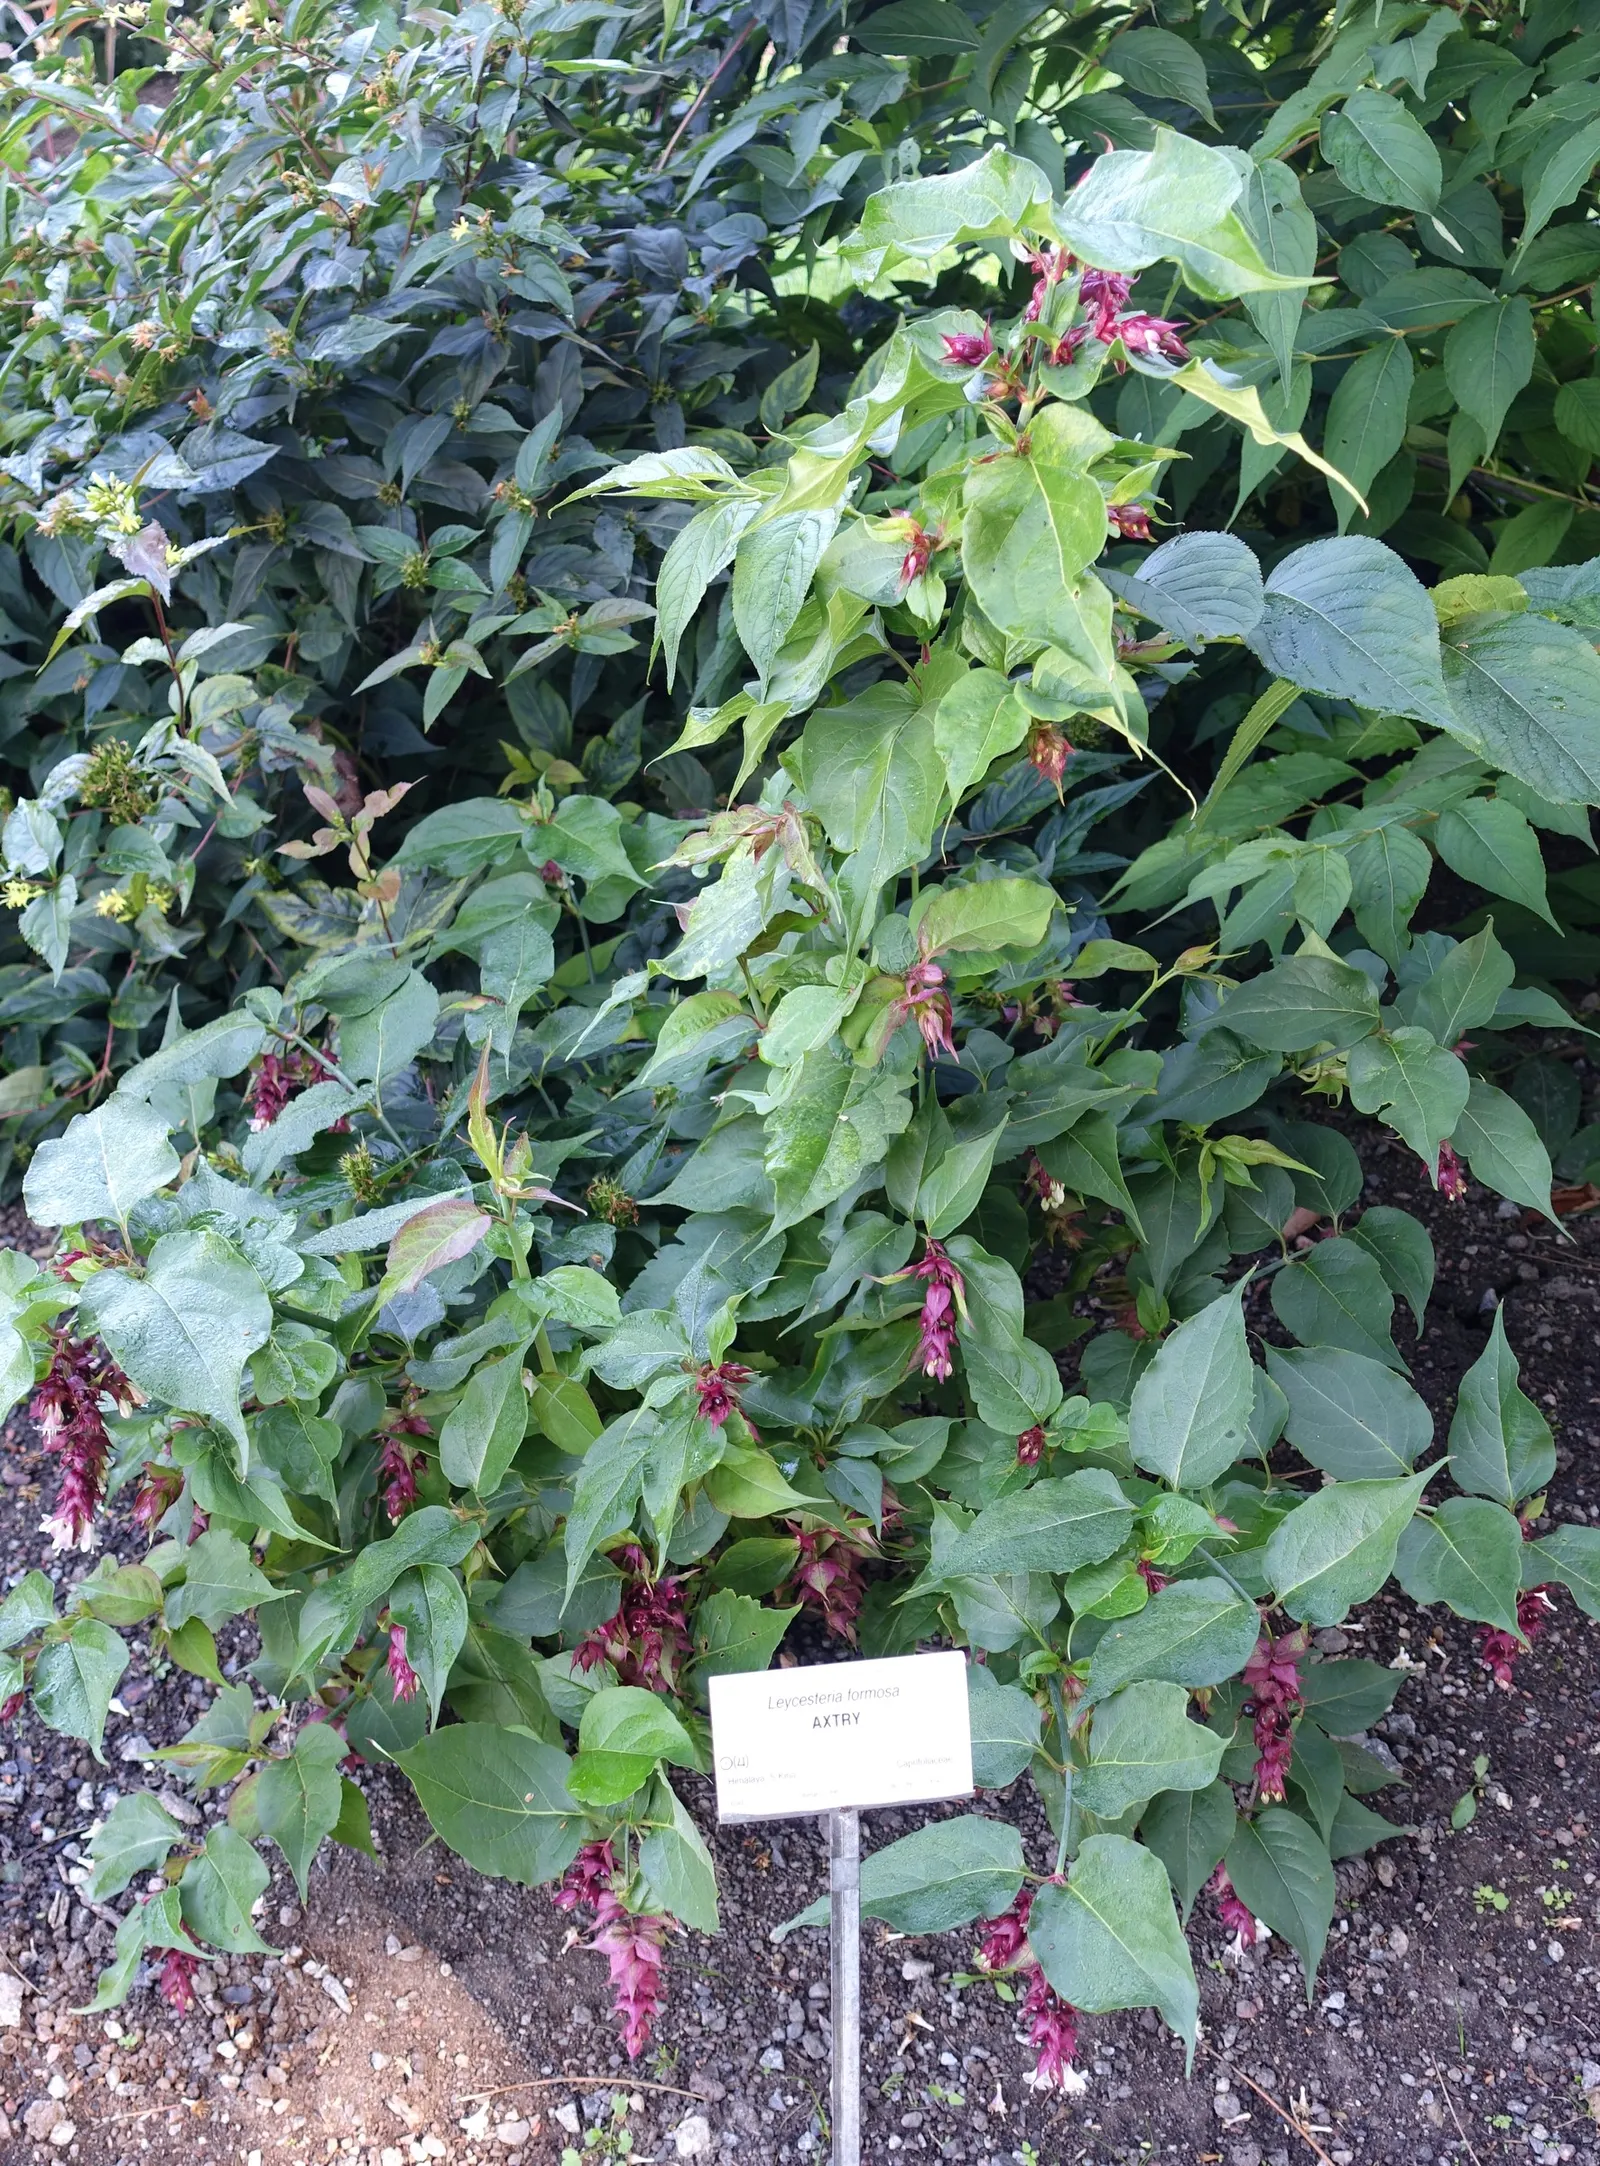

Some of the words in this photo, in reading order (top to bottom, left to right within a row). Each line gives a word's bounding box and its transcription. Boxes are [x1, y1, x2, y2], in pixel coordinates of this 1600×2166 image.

[768, 1691, 843, 1711] Leycesteria
[847, 1686, 901, 1701] formosa
[812, 1711, 861, 1729] AXTRY
